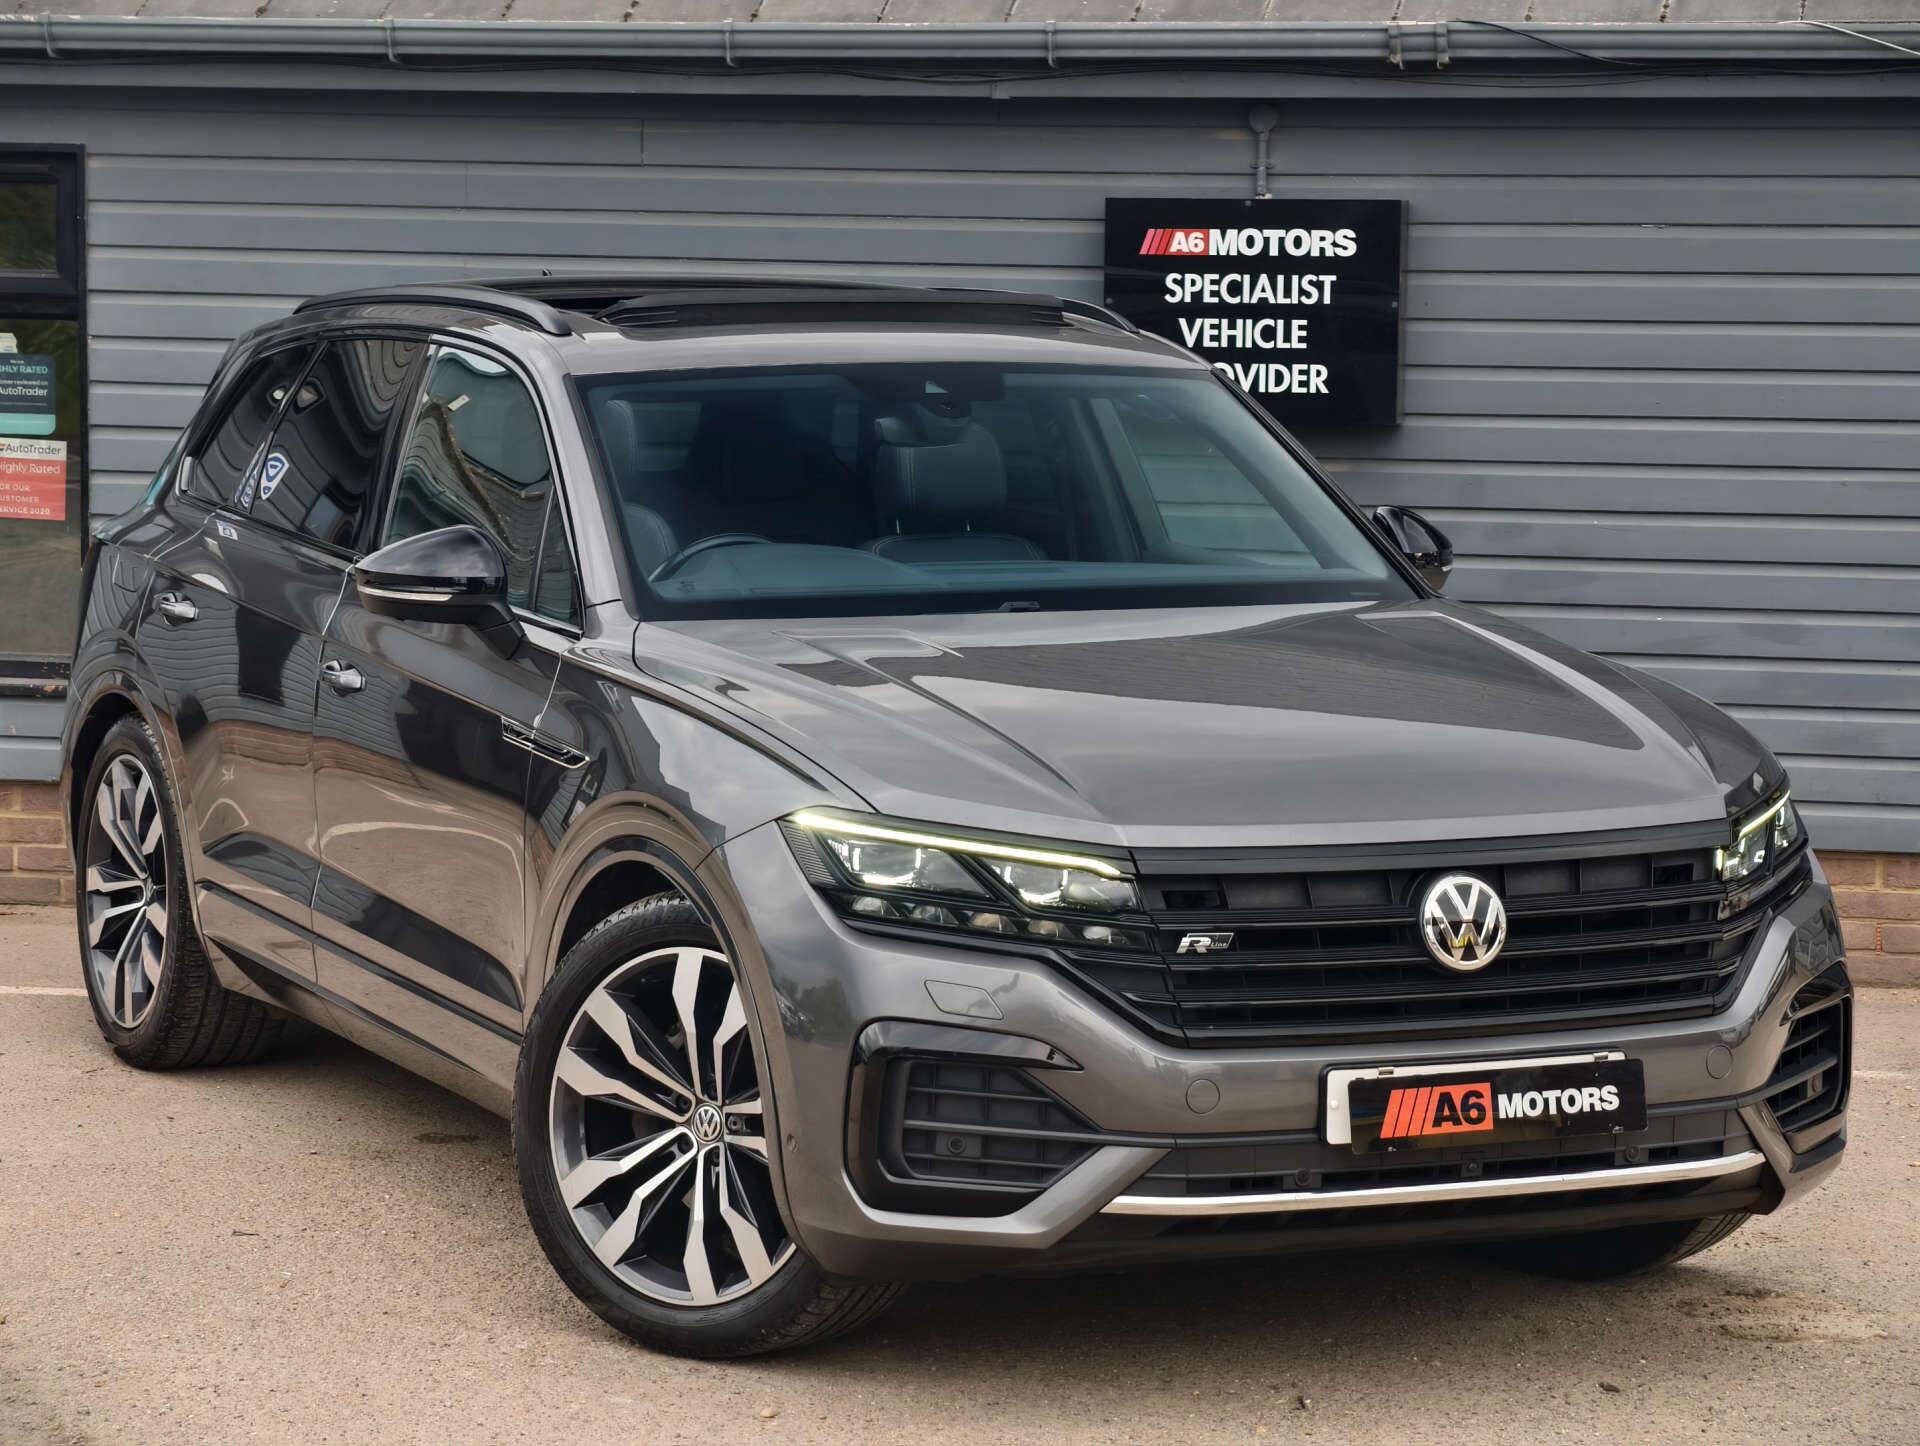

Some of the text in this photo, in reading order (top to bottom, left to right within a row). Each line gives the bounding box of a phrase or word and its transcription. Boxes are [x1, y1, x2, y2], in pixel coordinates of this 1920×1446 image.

[1169, 228, 1358, 257] A6 MOTORS
[1164, 273, 1337, 305] SPECIALIST
[1178, 318, 1308, 349] VEHICLE
[20, 365, 48, 374] RATED
[5, 443, 62, 457] AutoTrader
[29, 463, 61, 475] Rated
[12, 483, 32, 492] OUR
[30, 507, 50, 516] 2020
[1431, 1085, 1620, 1128] A6 MOTORS
